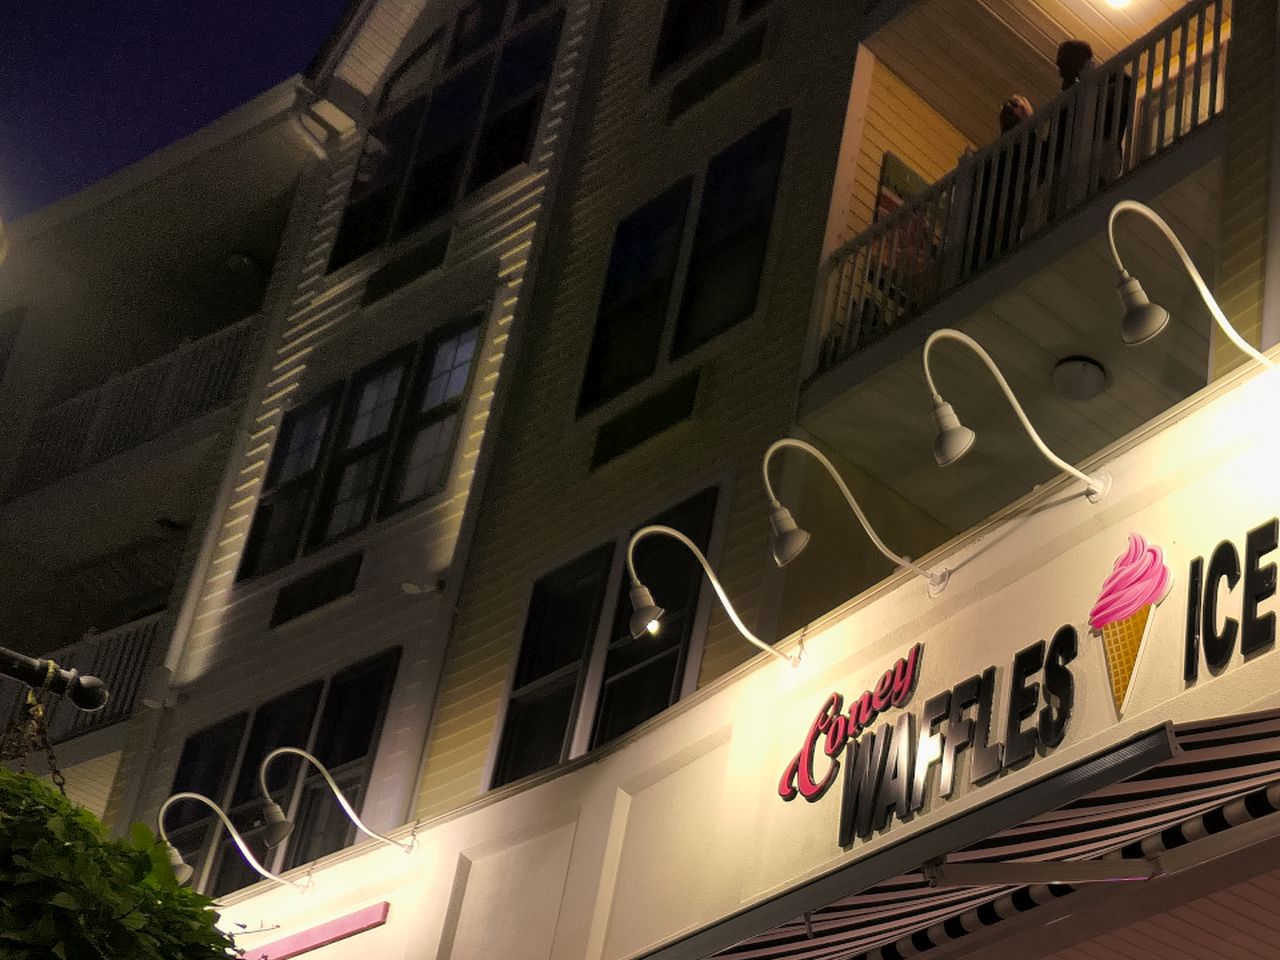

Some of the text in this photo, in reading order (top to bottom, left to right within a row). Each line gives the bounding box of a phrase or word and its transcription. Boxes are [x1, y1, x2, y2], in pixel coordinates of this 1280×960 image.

[1184, 516, 1280, 683] ICE
[778, 642, 924, 802] Coney
[838, 623, 1079, 848] WAFFLES
